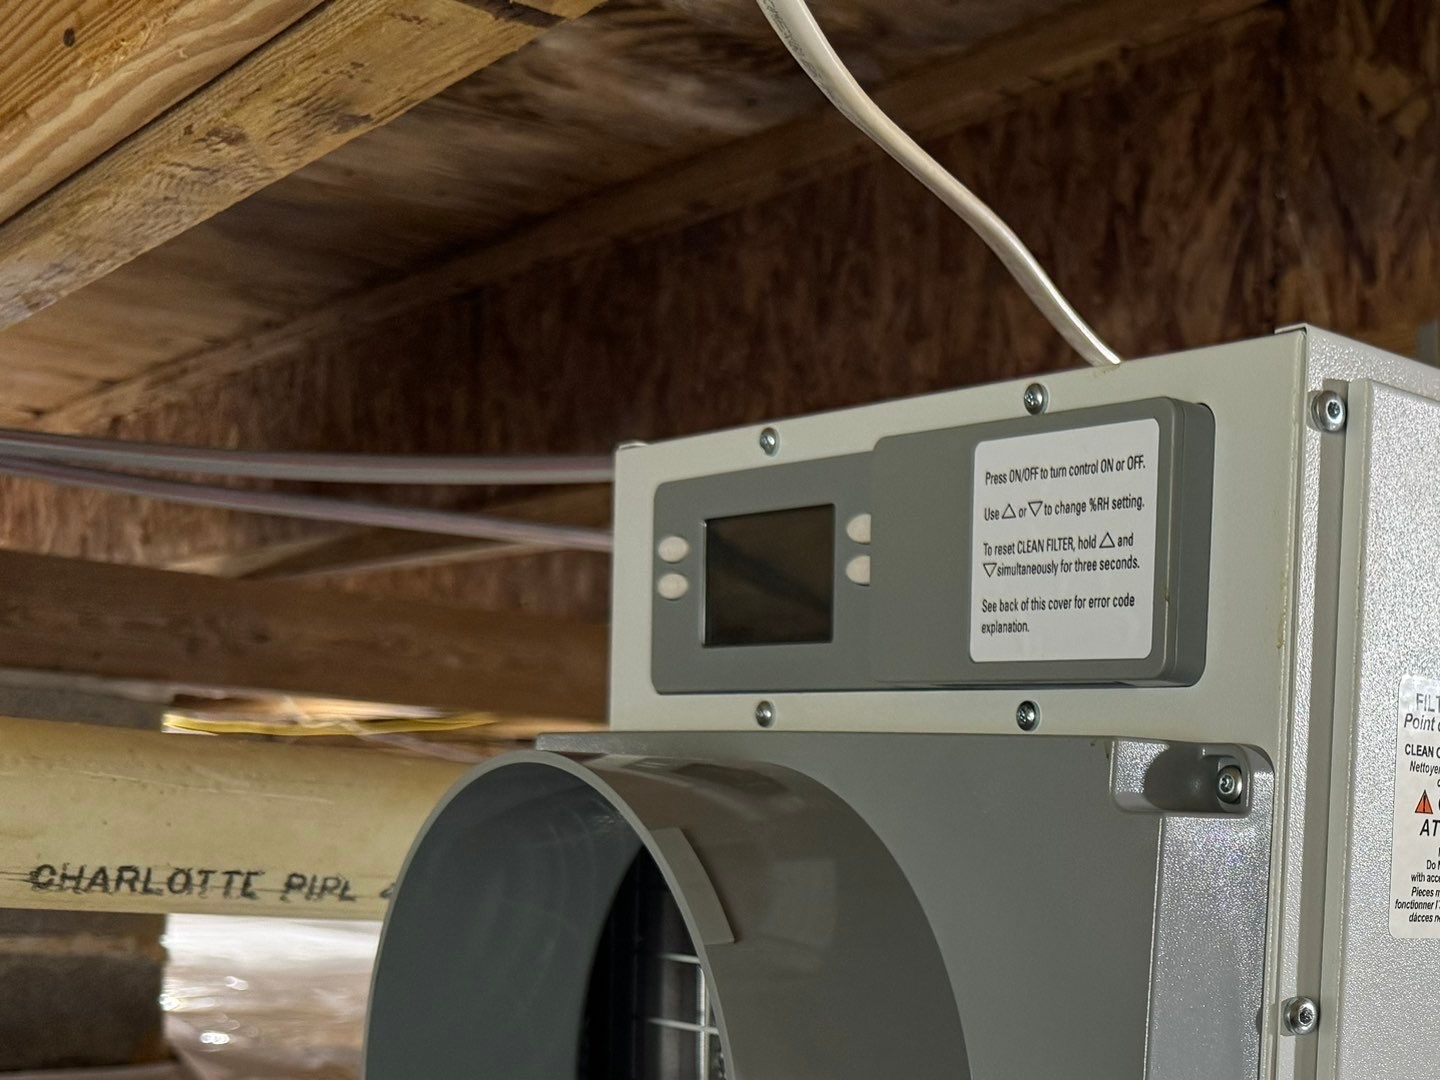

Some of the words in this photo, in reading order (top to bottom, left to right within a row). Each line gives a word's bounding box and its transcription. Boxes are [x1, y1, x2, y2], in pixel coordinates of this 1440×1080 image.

[985, 471, 1007, 485] Press
[1010, 466, 1039, 483] ON/OFF
[1041, 468, 1048, 480] to
[1050, 466, 1067, 479] turn
[1069, 460, 1098, 477] control
[1101, 458, 1113, 473] ON
[1116, 460, 1124, 472] or
[1127, 455, 1145, 470] OFF.
[984, 507, 999, 521] Use
[1019, 508, 1026, 517] or
[1044, 503, 1052, 516] to
[1055, 501, 1086, 518] change
[1089, 498, 1109, 511] %RH
[1111, 494, 1145, 511] setting.
[984, 542, 992, 556] To
[995, 542, 1015, 556] reset
[1017, 539, 1044, 554] CLEAN
[1047, 538, 1075, 553] FILTER,
[1078, 535, 1096, 549] hold
[1118, 533, 1133, 547] and
[997, 561, 1058, 577] simultaneously
[1060, 559, 1072, 572] for
[1074, 558, 1097, 572] three
[1100, 554, 1139, 570] seconds.
[982, 599, 997, 613] See
[1000, 598, 1018, 612] back
[1021, 597, 1029, 611] of
[1031, 597, 1046, 610] this
[1048, 597, 1072, 610] cover
[1074, 595, 1086, 608] for
[1089, 596, 1110, 608] error
[1113, 593, 1134, 607] code
[982, 619, 1029, 636] explanation.
[1404, 713, 1435, 731] Point
[1405, 744, 1434, 757] CLEAN
[1427, 860, 1436, 870] Do
[1411, 872, 1425, 882] with
[1411, 887, 1434, 897] Pieces
[1395, 899, 1433, 910] fonctionner
